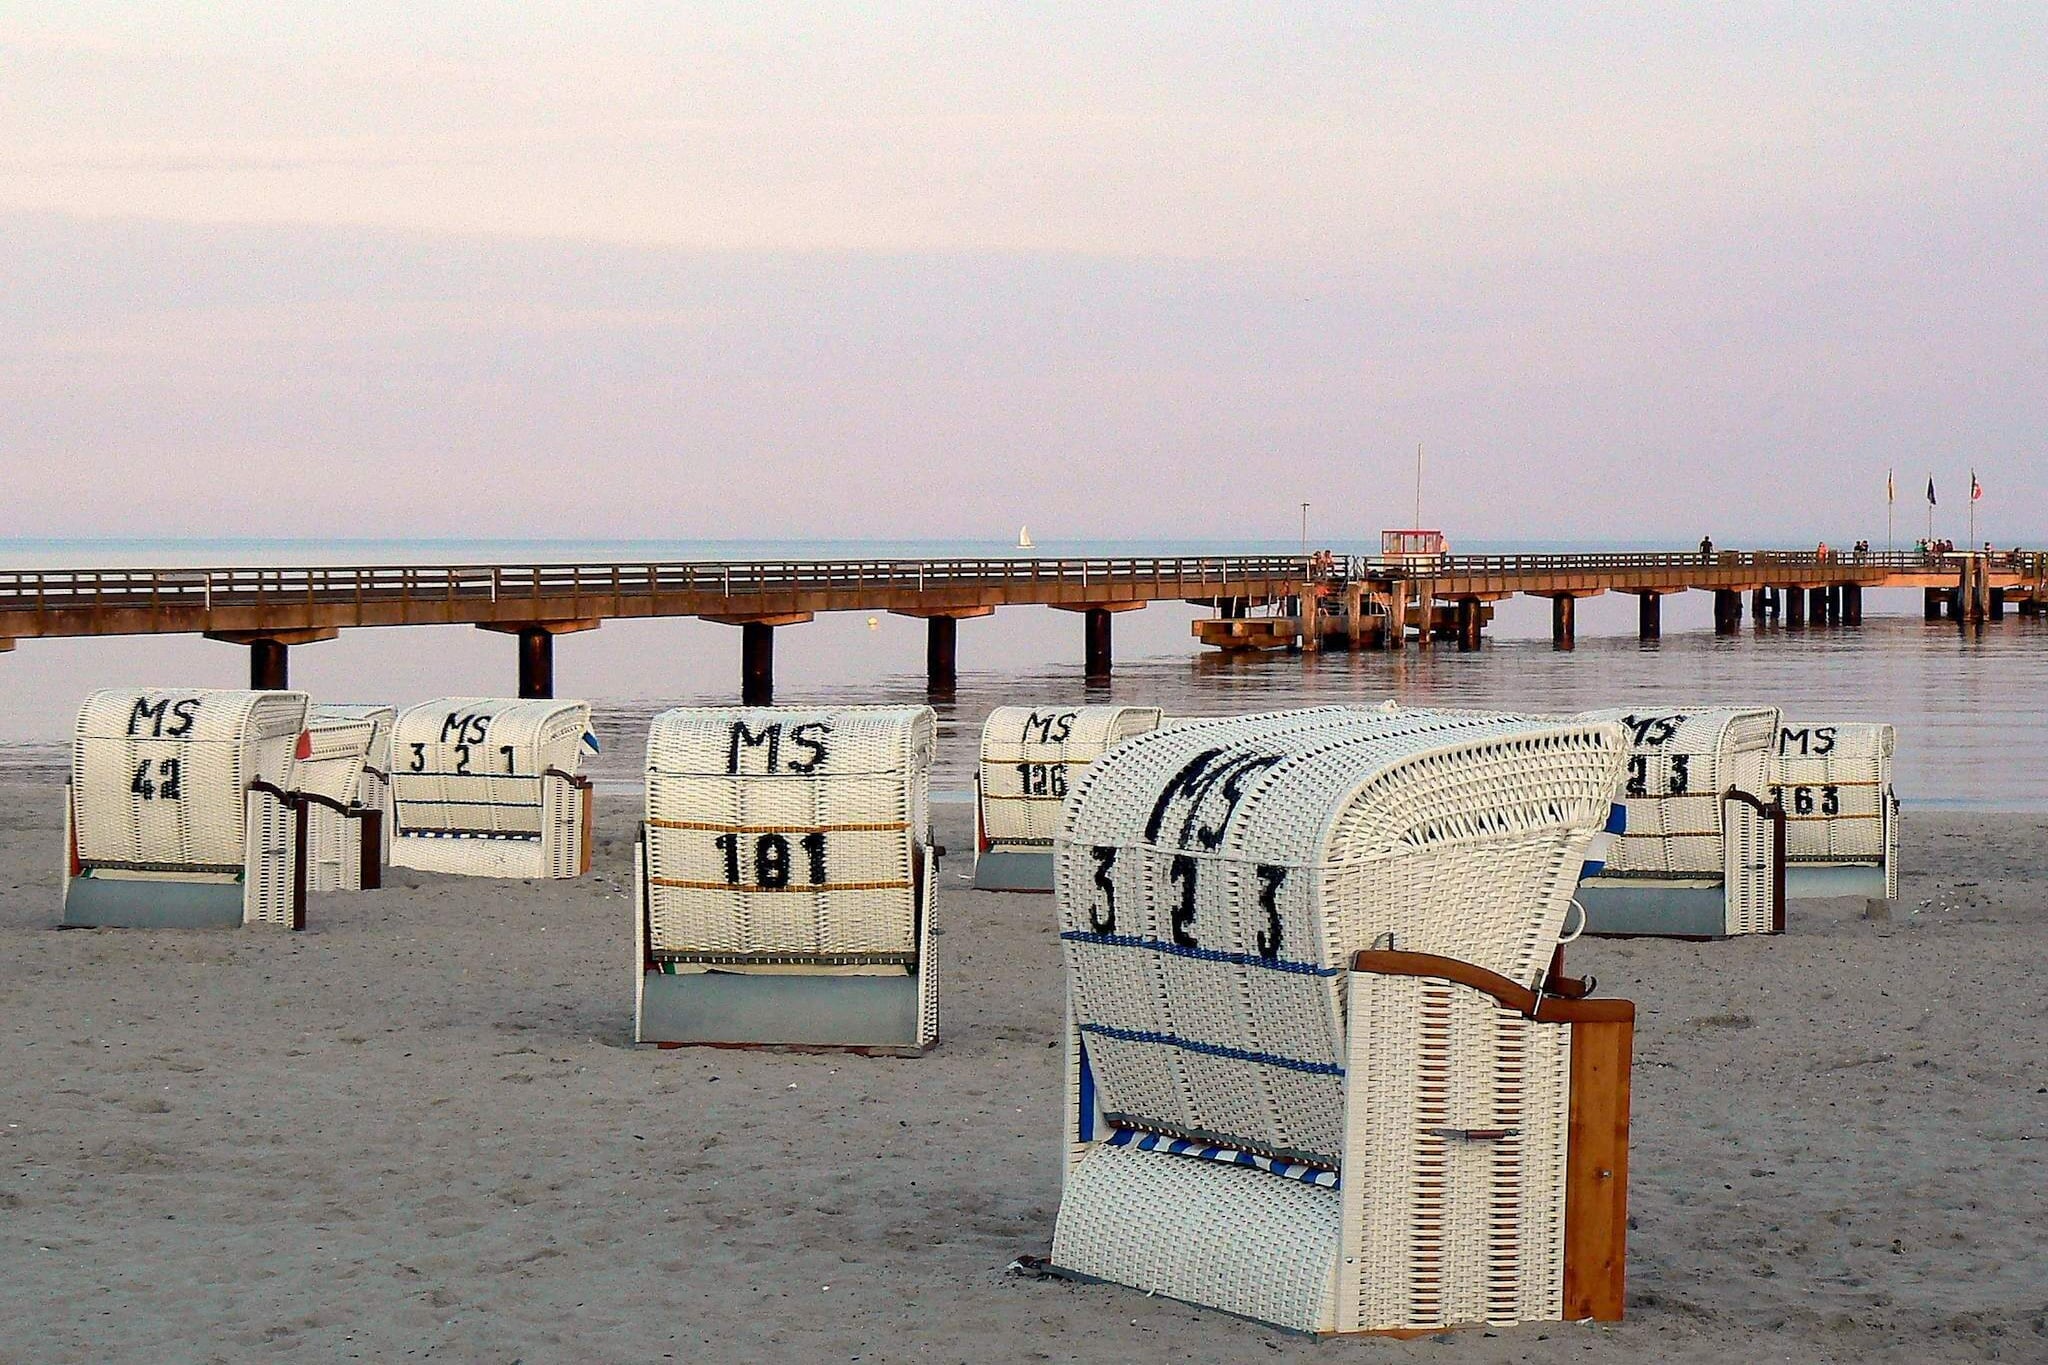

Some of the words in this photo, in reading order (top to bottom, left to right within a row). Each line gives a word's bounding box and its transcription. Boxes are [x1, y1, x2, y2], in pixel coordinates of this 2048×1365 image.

[126, 696, 201, 736] MS
[440, 713, 492, 744] MS
[1021, 712, 1077, 744] MS
[727, 721, 832, 774] MS
[1779, 727, 1837, 755] MS
[131, 758, 181, 800] 42
[1016, 763, 1070, 796] 126
[1145, 748, 1286, 850] MS
[715, 833, 826, 888] 181
